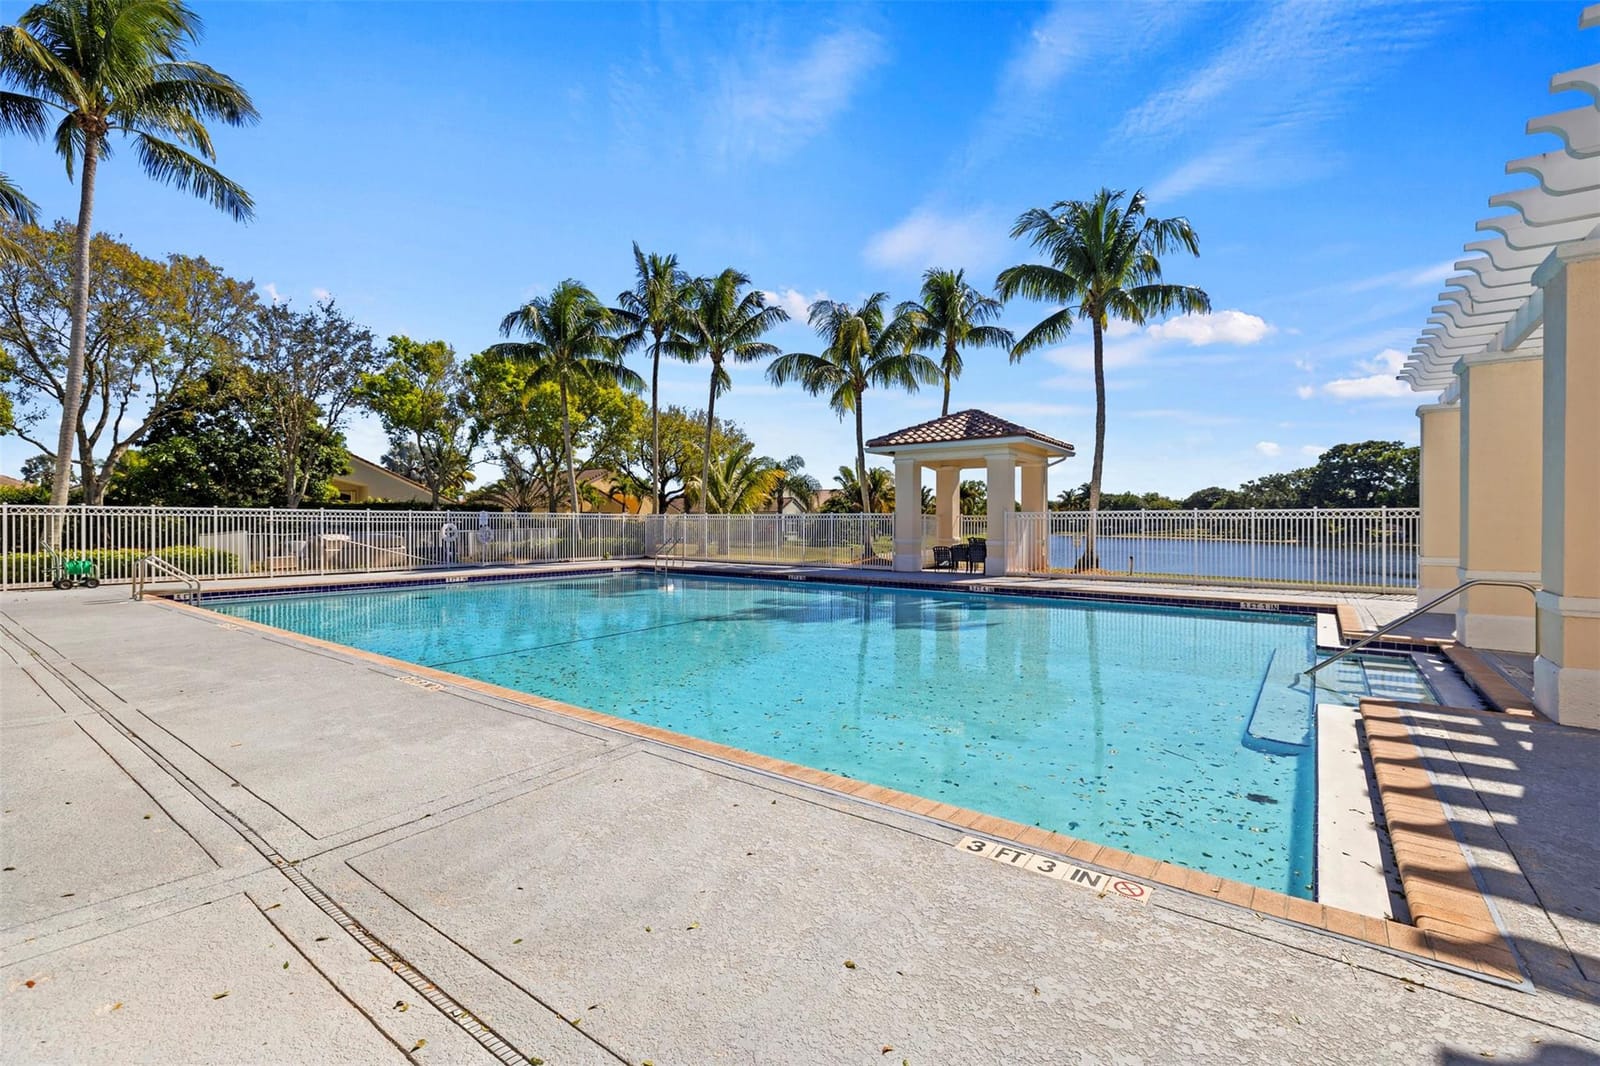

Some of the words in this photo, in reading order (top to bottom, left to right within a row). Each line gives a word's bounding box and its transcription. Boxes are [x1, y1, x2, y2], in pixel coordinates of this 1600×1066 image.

[966, 840, 986, 853] 3
[994, 847, 1027, 863] FT
[1037, 860, 1055, 873] 3
[1069, 869, 1101, 887] IN
